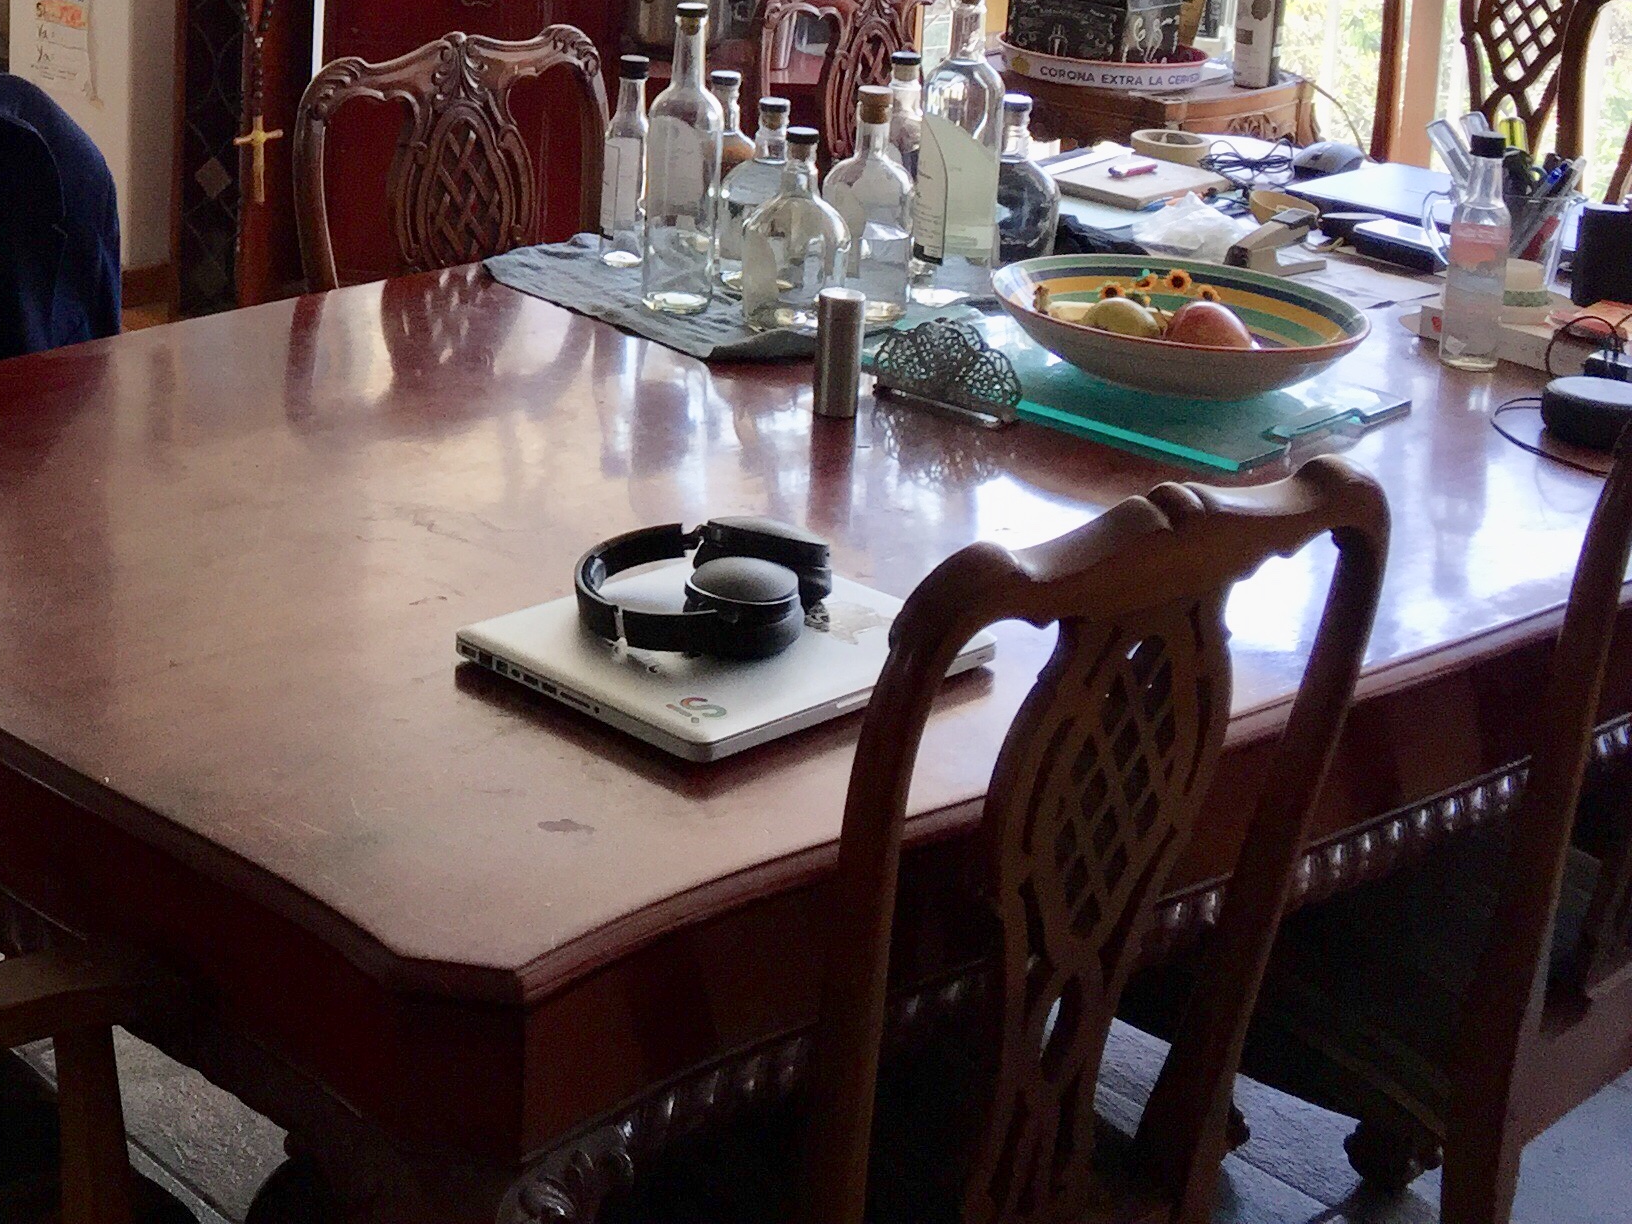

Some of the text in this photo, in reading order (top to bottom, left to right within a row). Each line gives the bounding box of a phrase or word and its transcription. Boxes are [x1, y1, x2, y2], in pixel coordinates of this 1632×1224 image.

[1040, 65, 1095, 82] CORONA
[1101, 73, 1144, 86] EXTRA
[1148, 75, 1164, 86] LA
